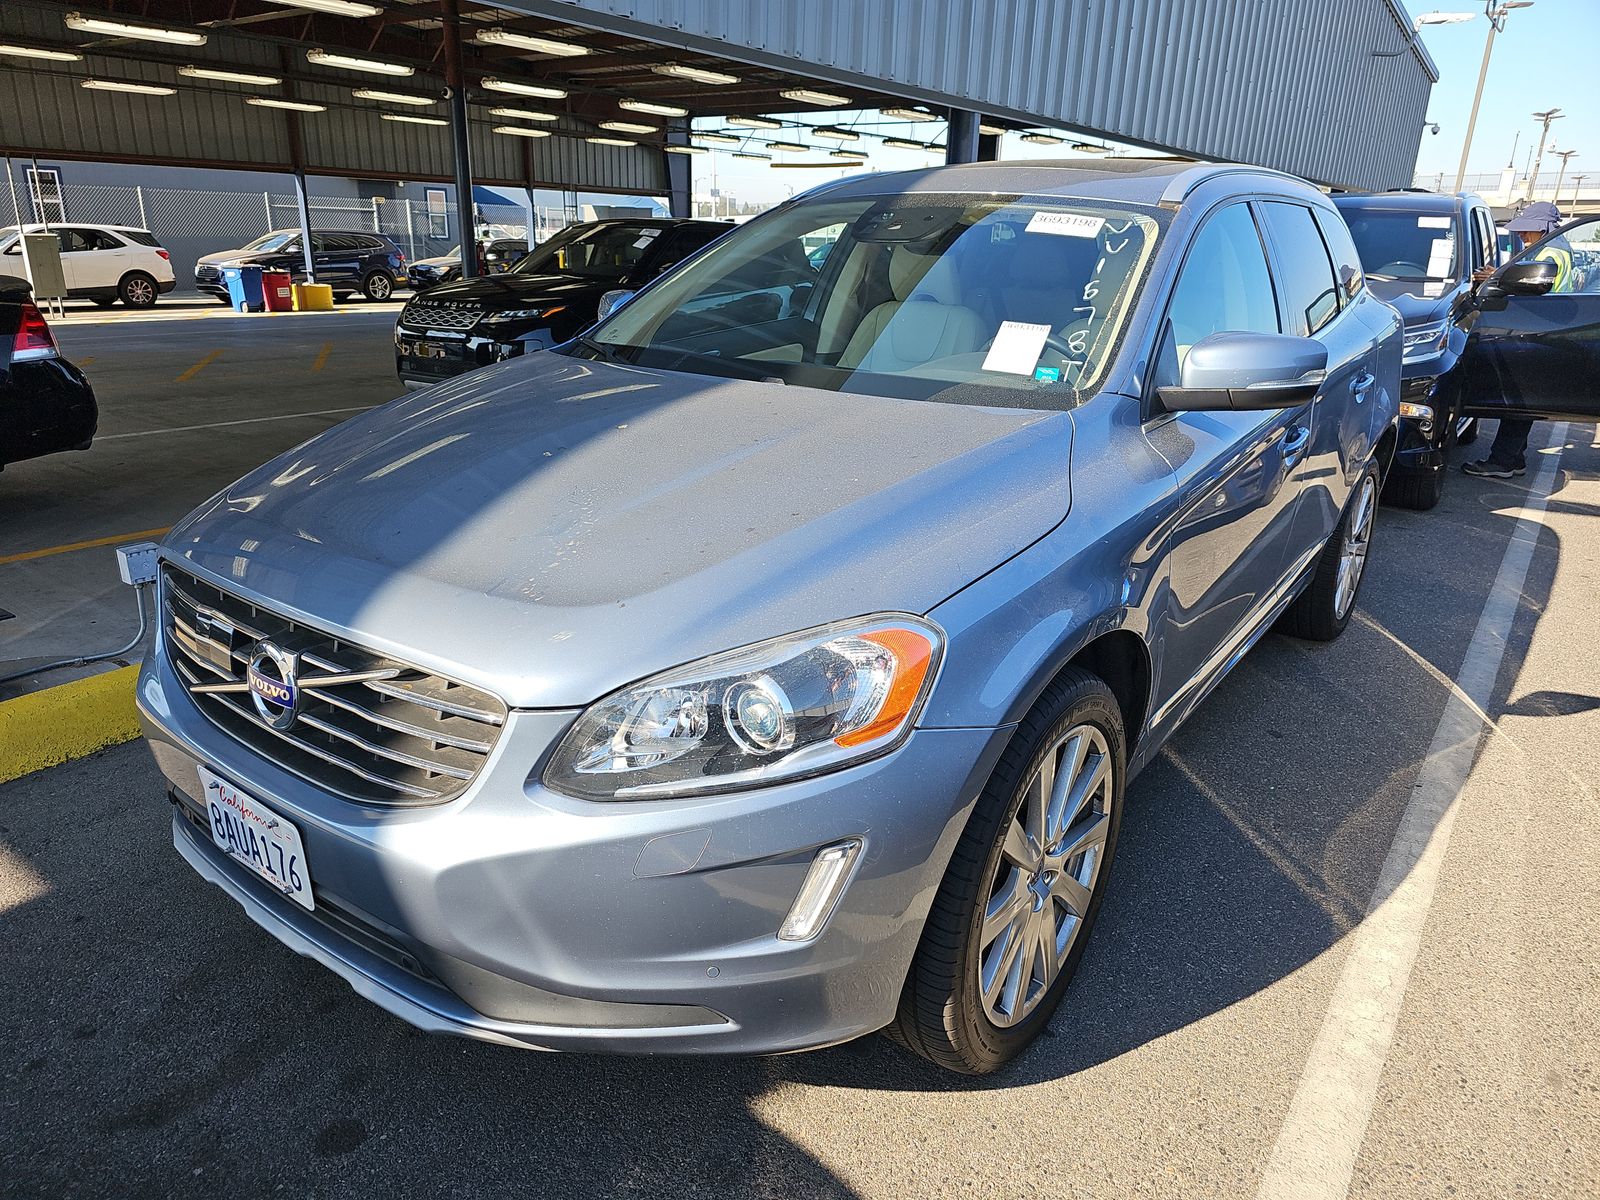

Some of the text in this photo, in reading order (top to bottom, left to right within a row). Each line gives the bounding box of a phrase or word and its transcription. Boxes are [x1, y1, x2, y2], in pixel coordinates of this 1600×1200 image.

[1034, 214, 1098, 228] 3693198
[249, 672, 290, 701] VOLVO
[211, 802, 303, 892] 8AUA176
